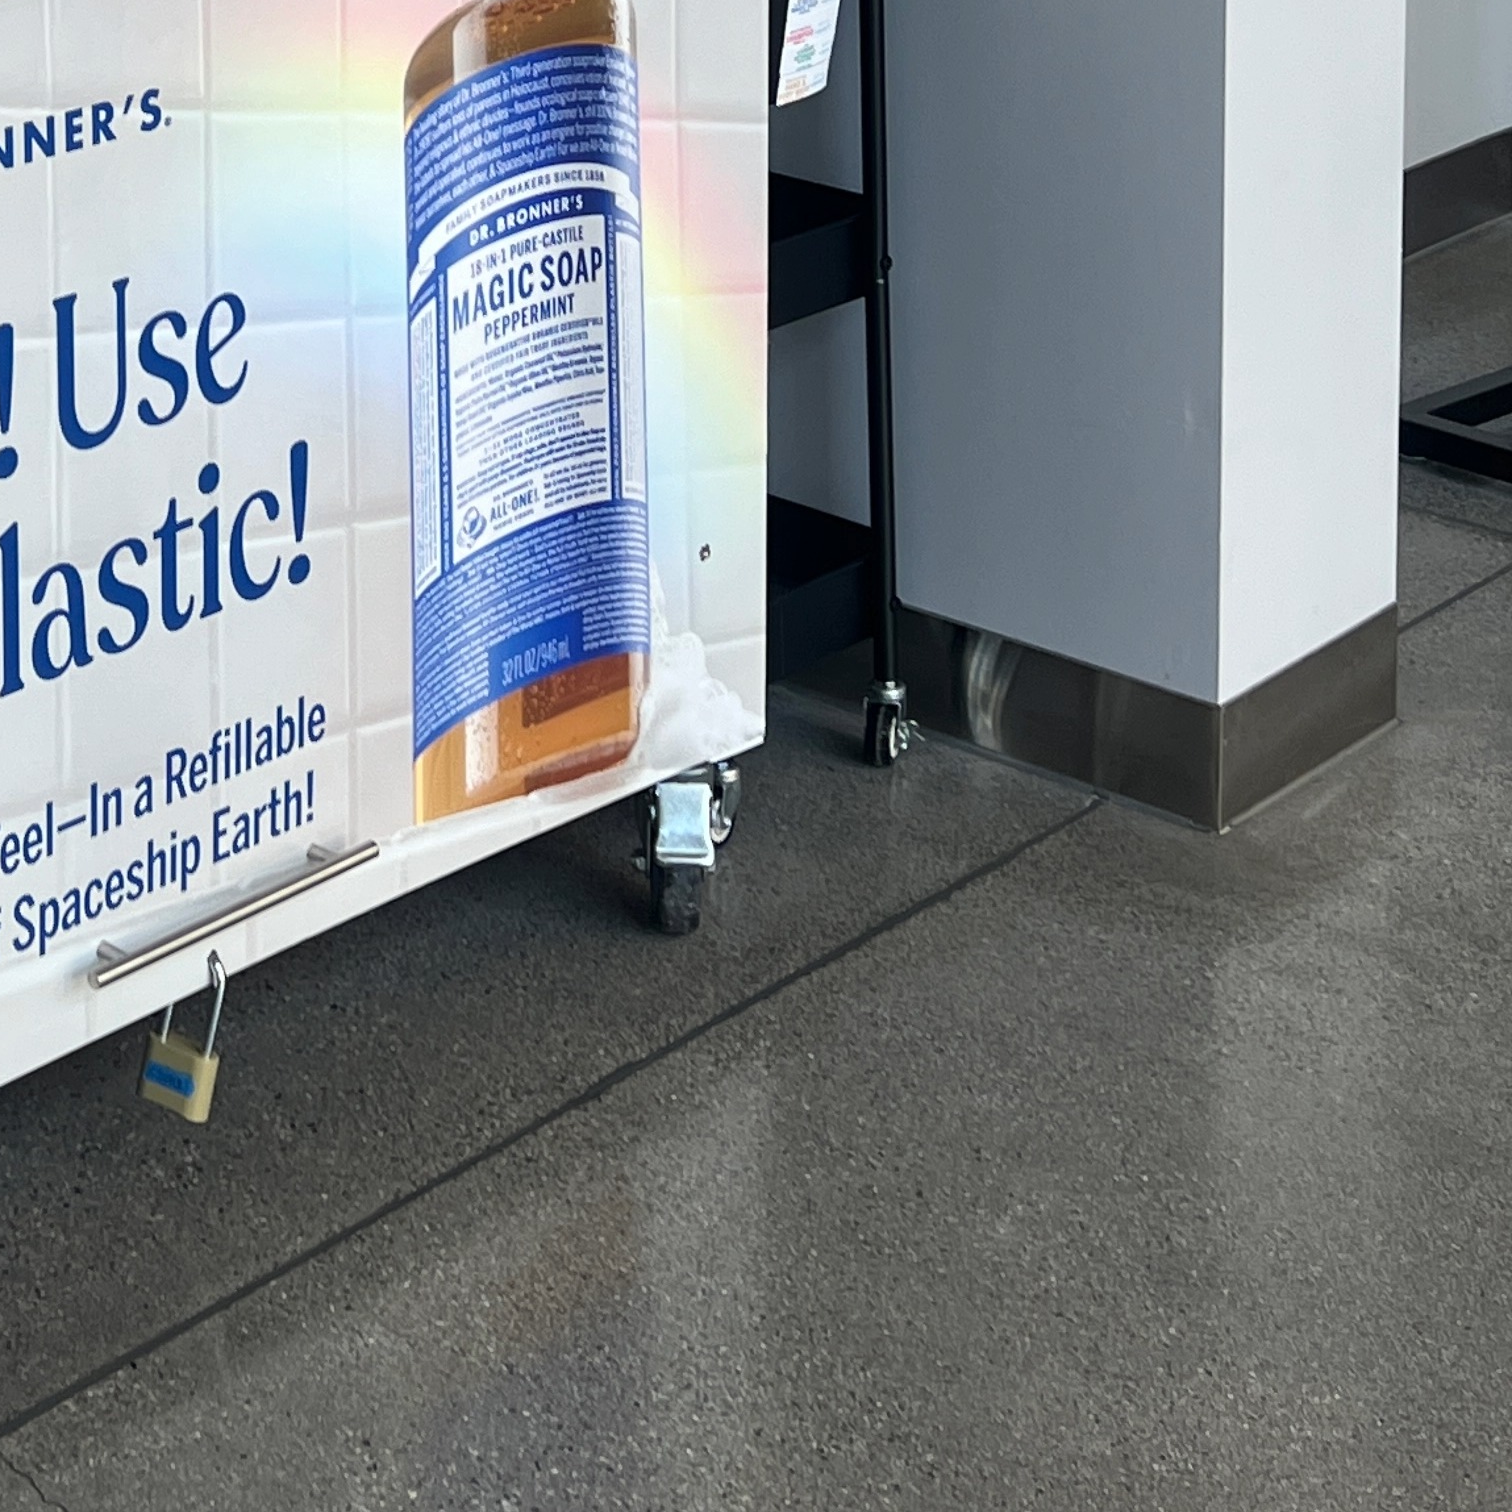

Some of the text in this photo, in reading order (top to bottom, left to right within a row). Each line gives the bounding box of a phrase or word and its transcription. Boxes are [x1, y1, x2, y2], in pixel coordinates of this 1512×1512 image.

[445, 204, 478, 236] FAMILY
[480, 173, 551, 213] SOAPMAKERS
[554, 169, 583, 183] SINCE
[469, 194, 583, 247] DR. BRONNER'S
[470, 225, 584, 279] 18-IN-1 PURE-CASTILE
[453, 246, 603, 334] MAGIC SOAP
[484, 292, 575, 344] PEPPERMINT
[53, 277, 248, 450] Use
[489, 488, 540, 522] ALL-ONE!
[133, 772, 153, 816] a
[165, 695, 326, 806] Refillable
[12, 831, 200, 956] Spaceship
[212, 770, 316, 862] Earth!
